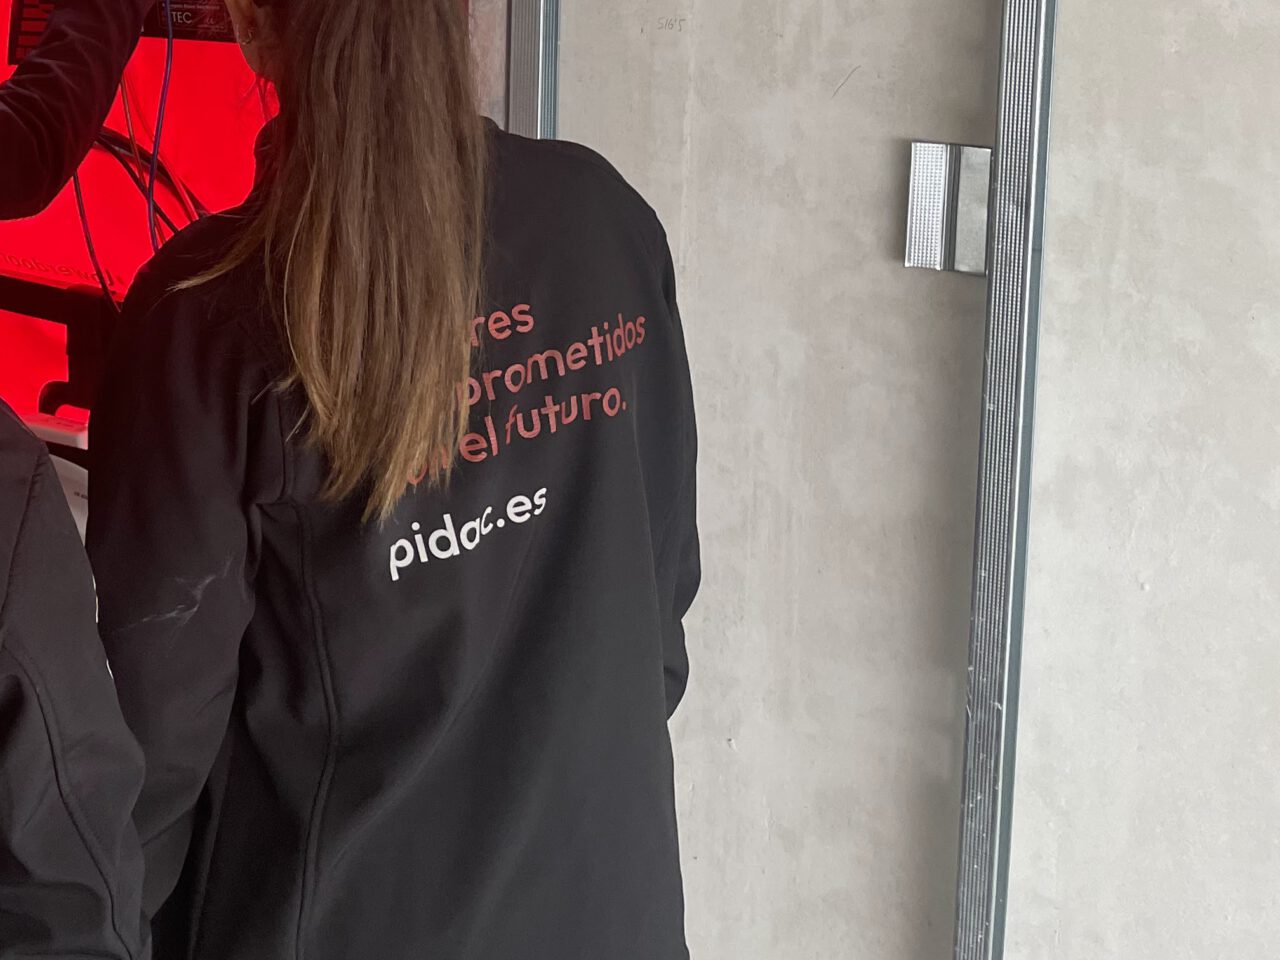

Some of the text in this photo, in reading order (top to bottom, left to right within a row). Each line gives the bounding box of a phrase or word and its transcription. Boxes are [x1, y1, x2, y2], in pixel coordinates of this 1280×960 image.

[171, 11, 193, 24] TEC
[456, 313, 646, 411] prometidos
[470, 303, 534, 347] res
[459, 387, 627, 463] el futuro.
[390, 488, 547, 581] pidac.es
